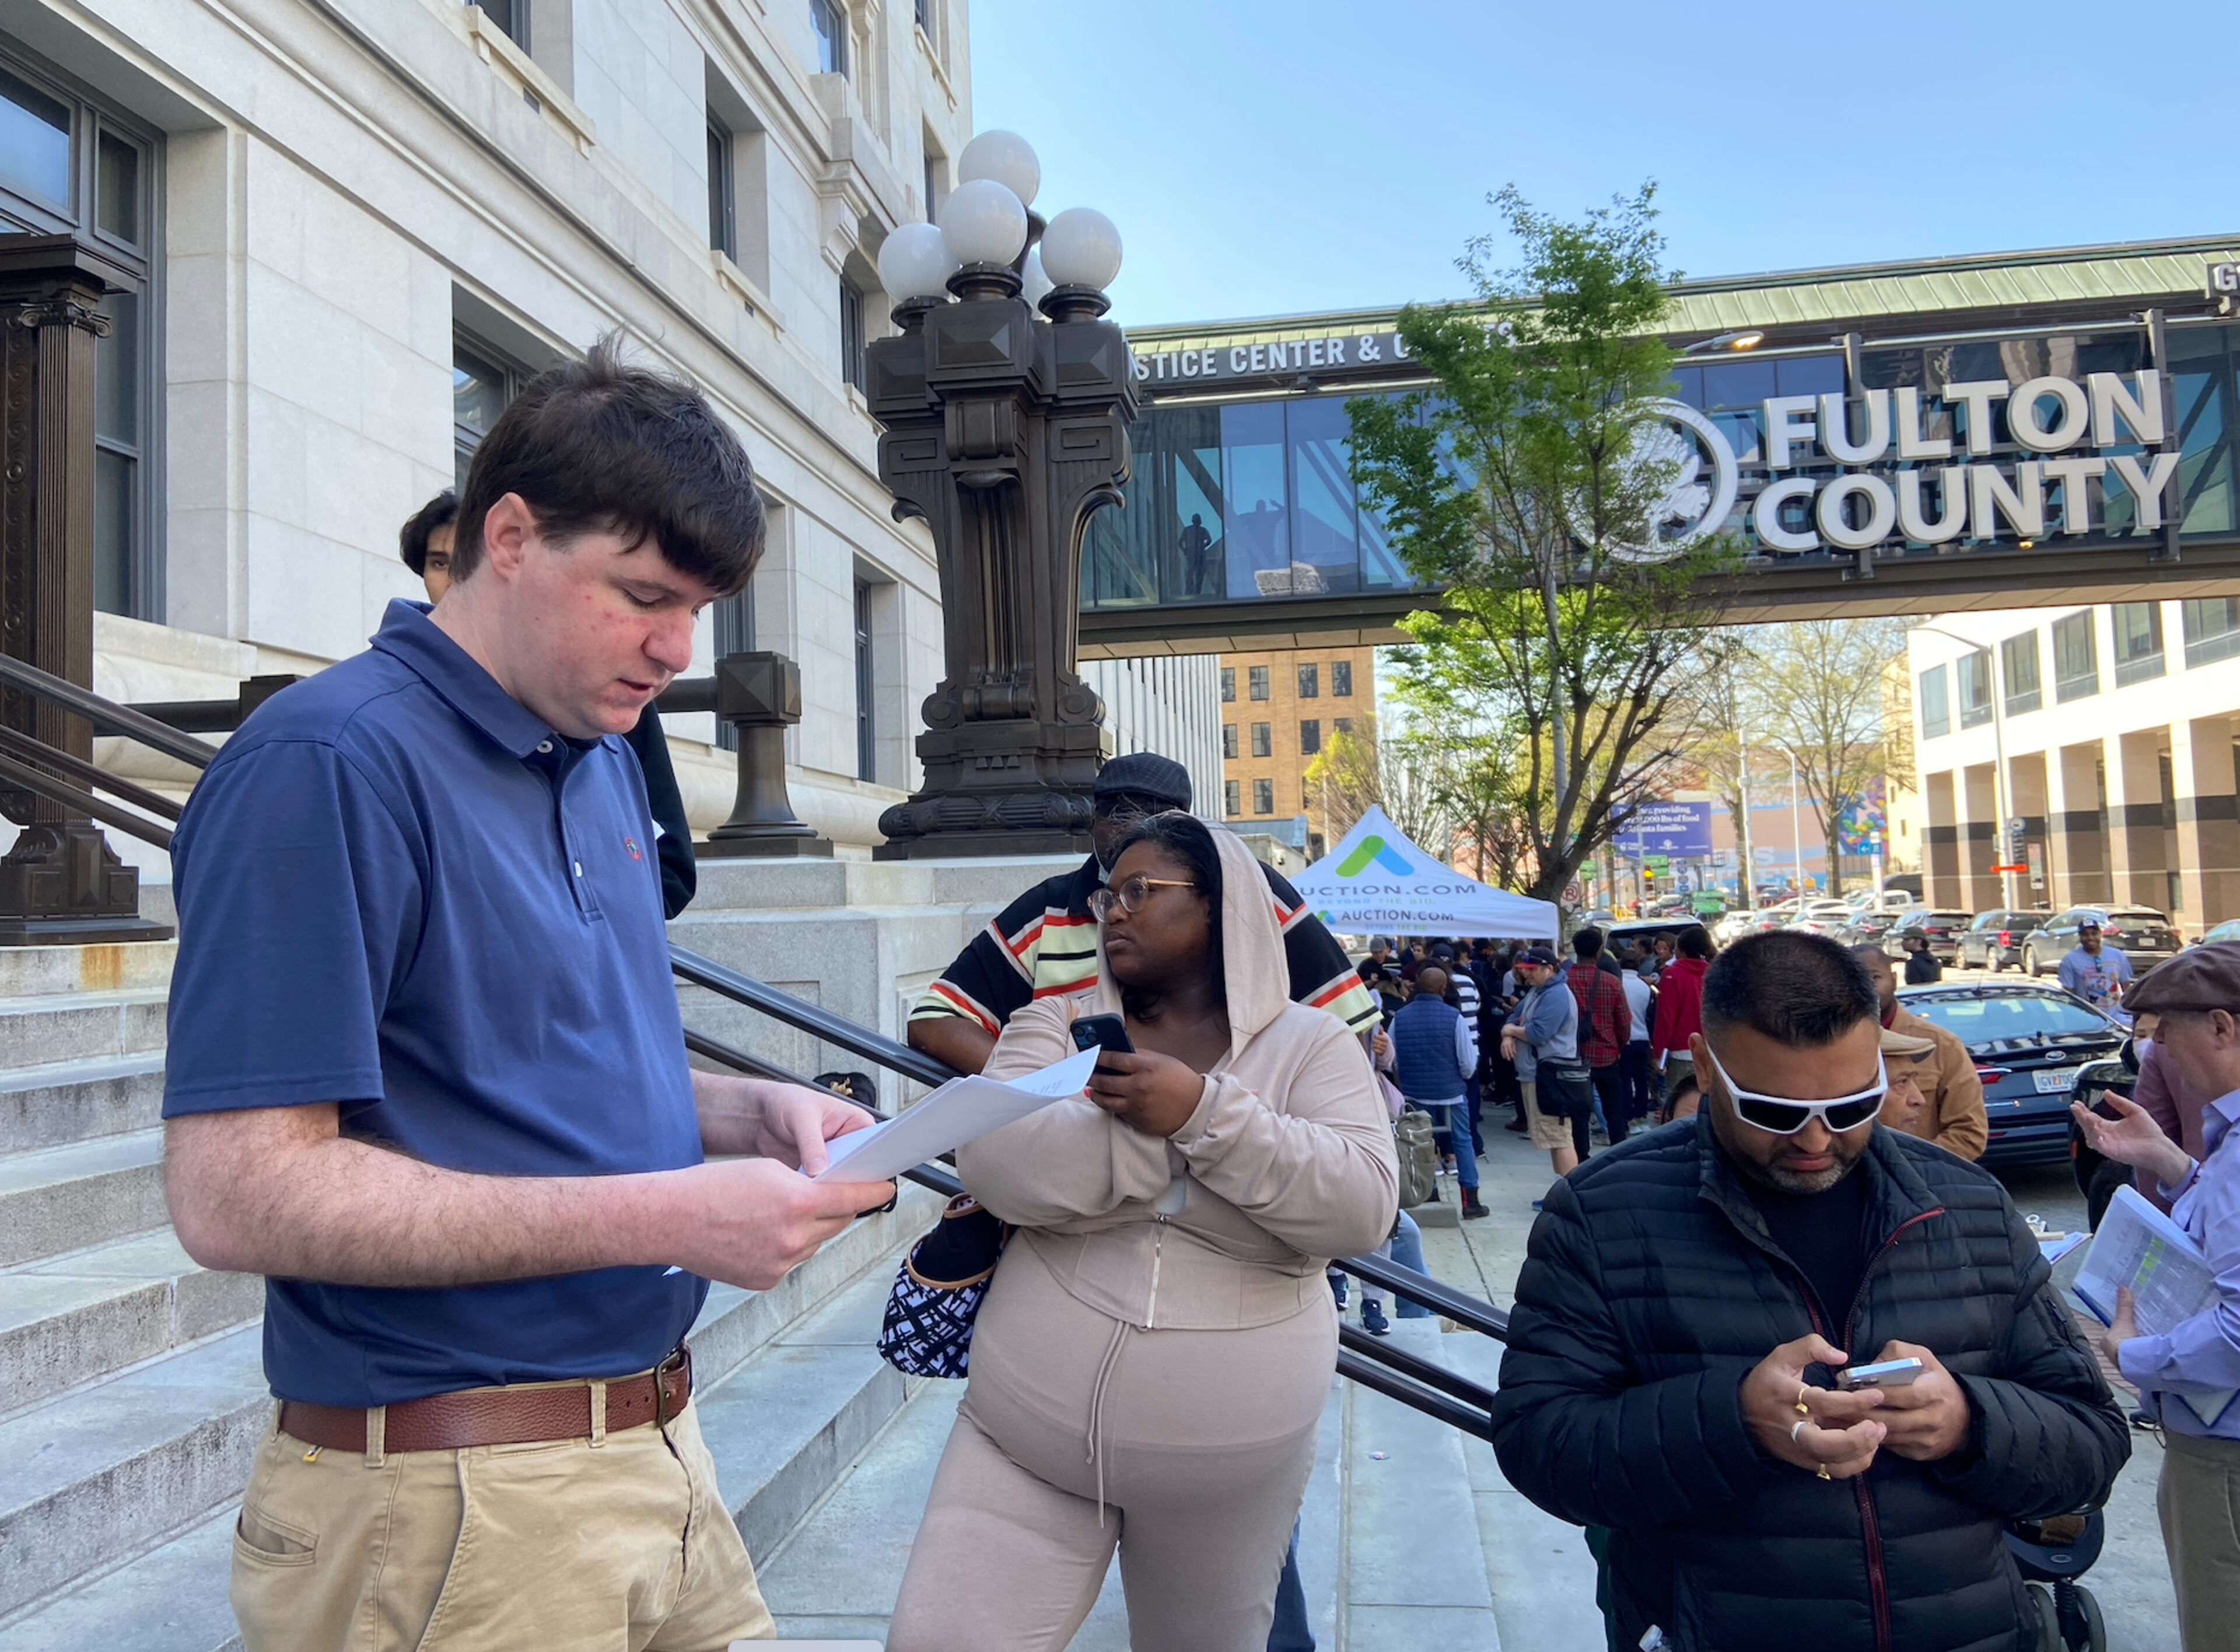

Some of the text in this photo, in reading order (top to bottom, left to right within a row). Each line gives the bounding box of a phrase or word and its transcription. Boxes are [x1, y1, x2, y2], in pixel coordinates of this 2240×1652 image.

[1230, 338, 1346, 373] CENTER
[1358, 335, 1381, 362] &
[1763, 369, 2164, 470] FULTON
[1752, 452, 2182, 552] COUNTY
[1654, 806, 1690, 815] providing
[1682, 814, 1699, 822] food
[1341, 909, 1454, 921] AUCTION.COM
